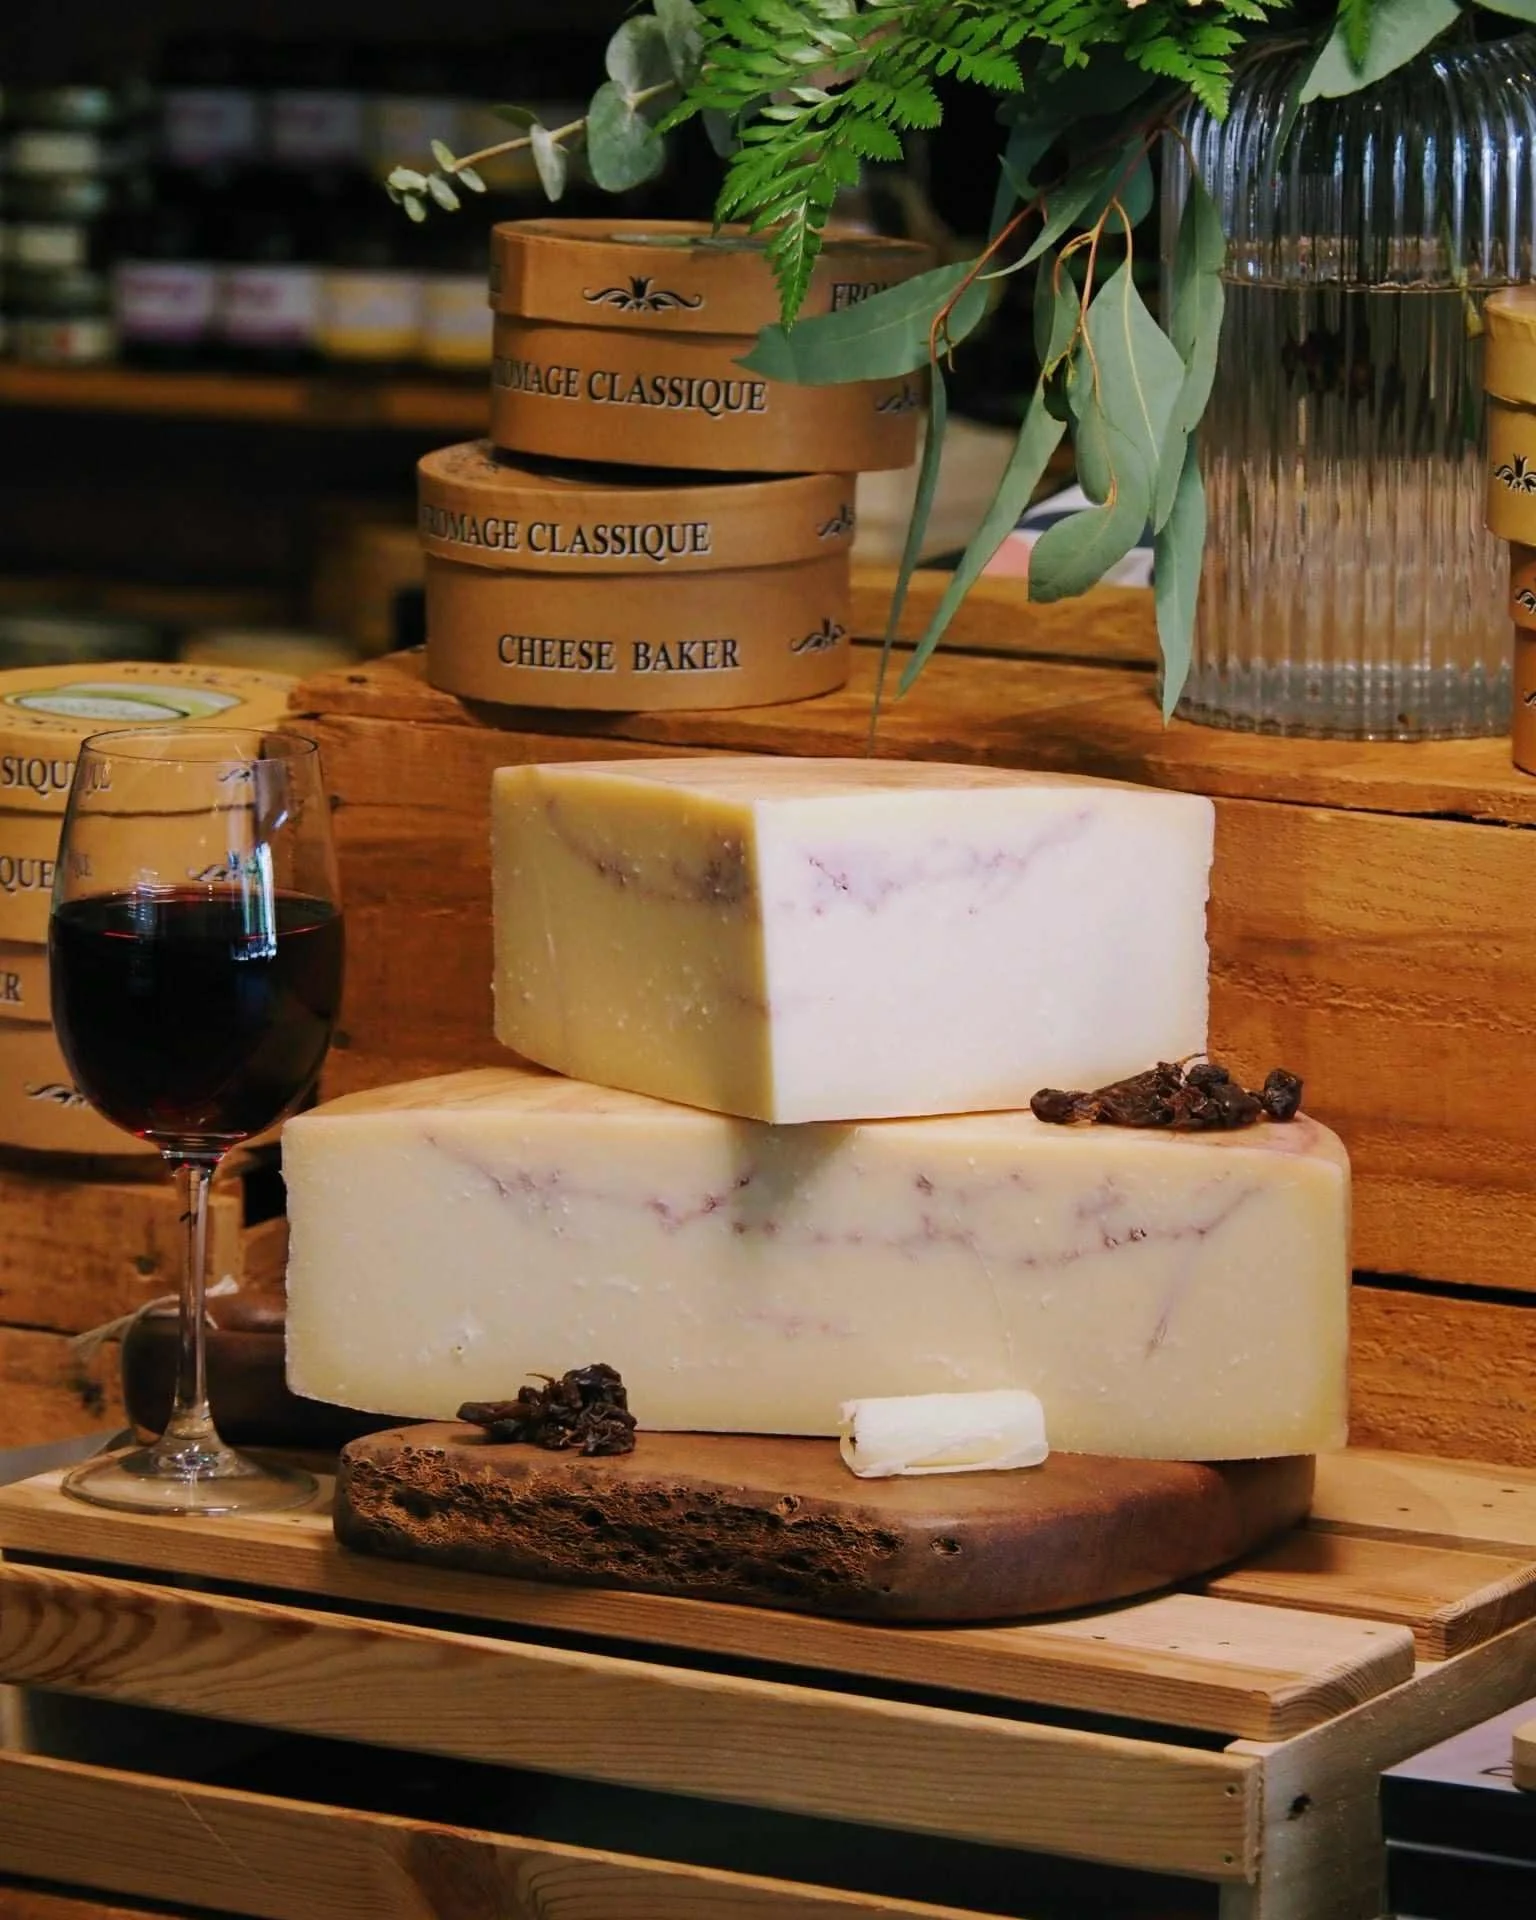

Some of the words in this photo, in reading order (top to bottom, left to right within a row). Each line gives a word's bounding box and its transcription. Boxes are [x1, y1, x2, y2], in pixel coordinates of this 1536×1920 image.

[587, 370, 767, 418] CLASSIQUE
[527, 521, 711, 562] CLASSIQUE
[497, 634, 615, 672] CHEESE
[632, 639, 741, 672] BAKER
